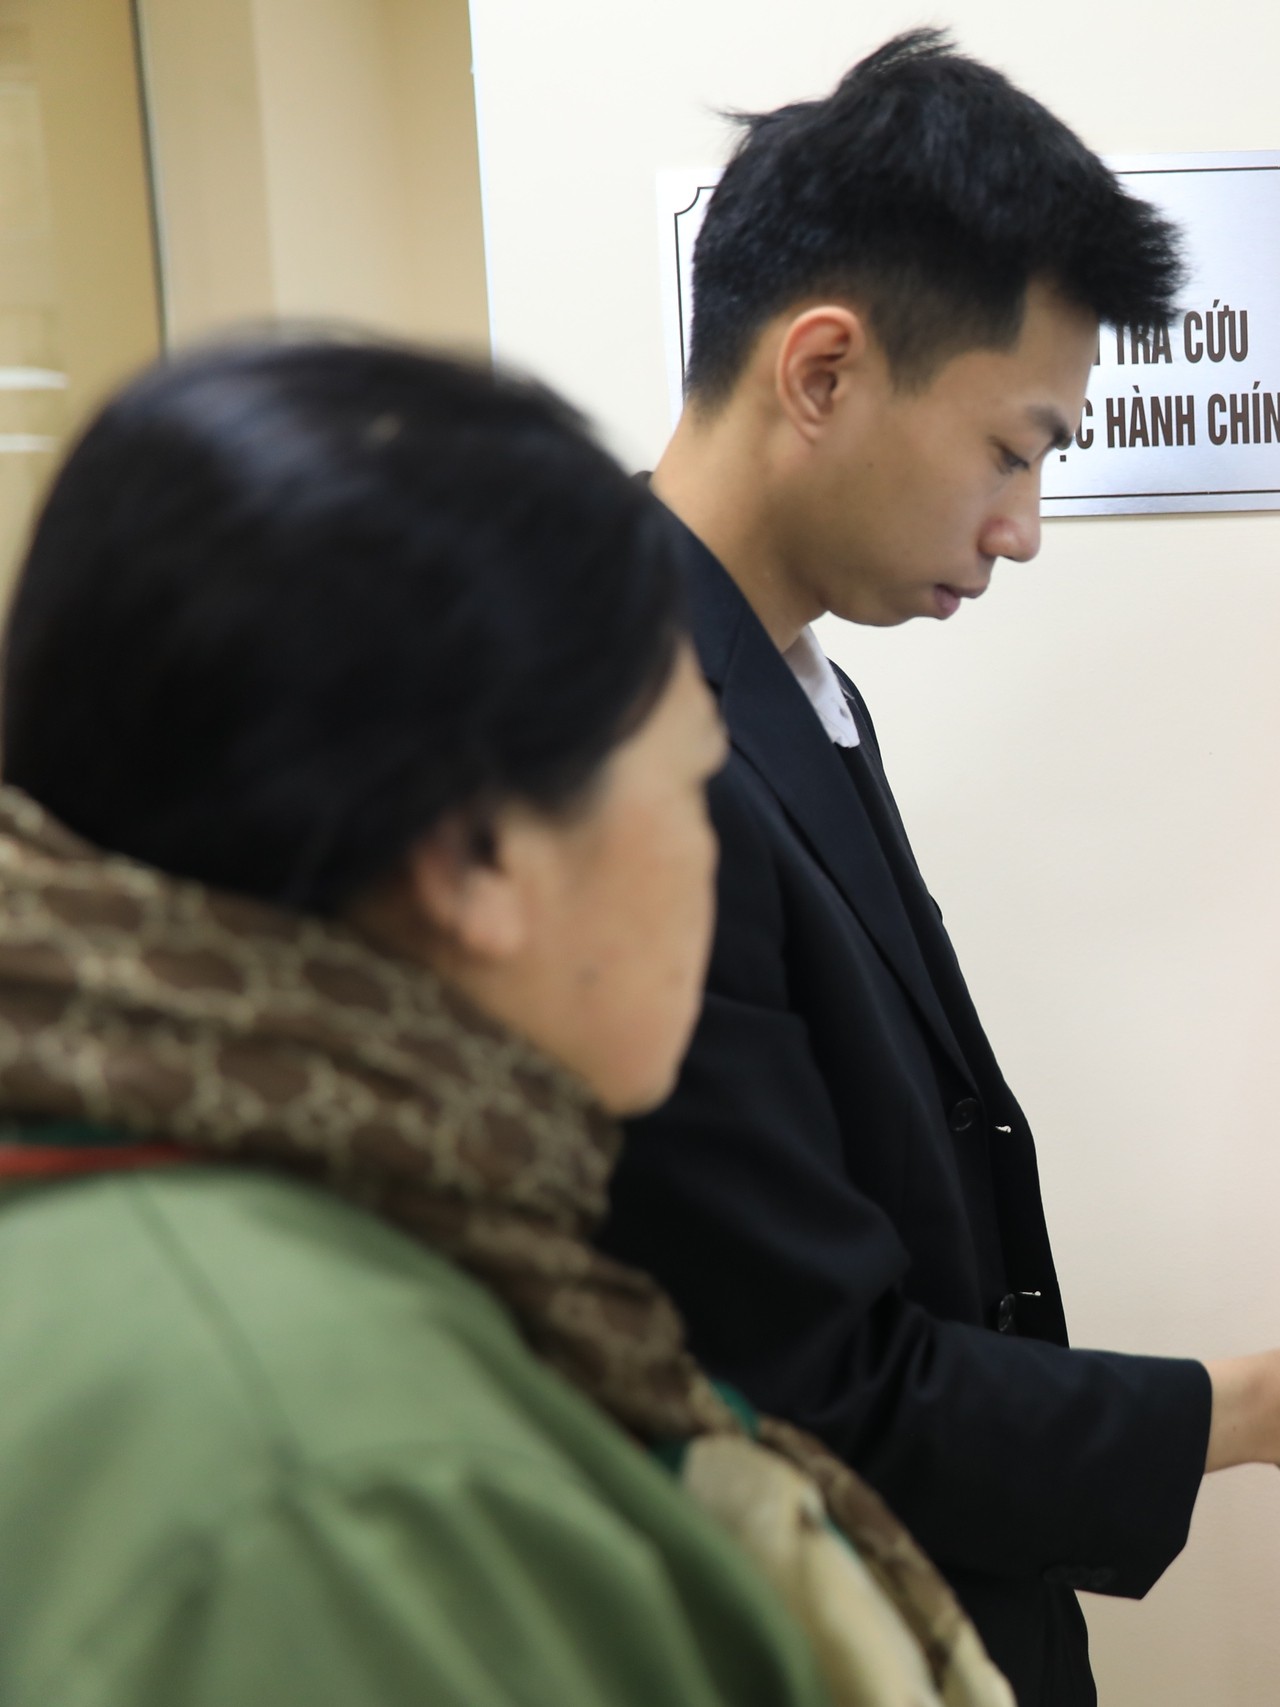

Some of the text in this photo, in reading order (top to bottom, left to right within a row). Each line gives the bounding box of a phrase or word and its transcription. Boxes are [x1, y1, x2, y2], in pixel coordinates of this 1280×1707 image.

[1115, 317, 1173, 365] TRA
[1183, 299, 1249, 364] CỨU
[1105, 385, 1196, 448] HÀNH
